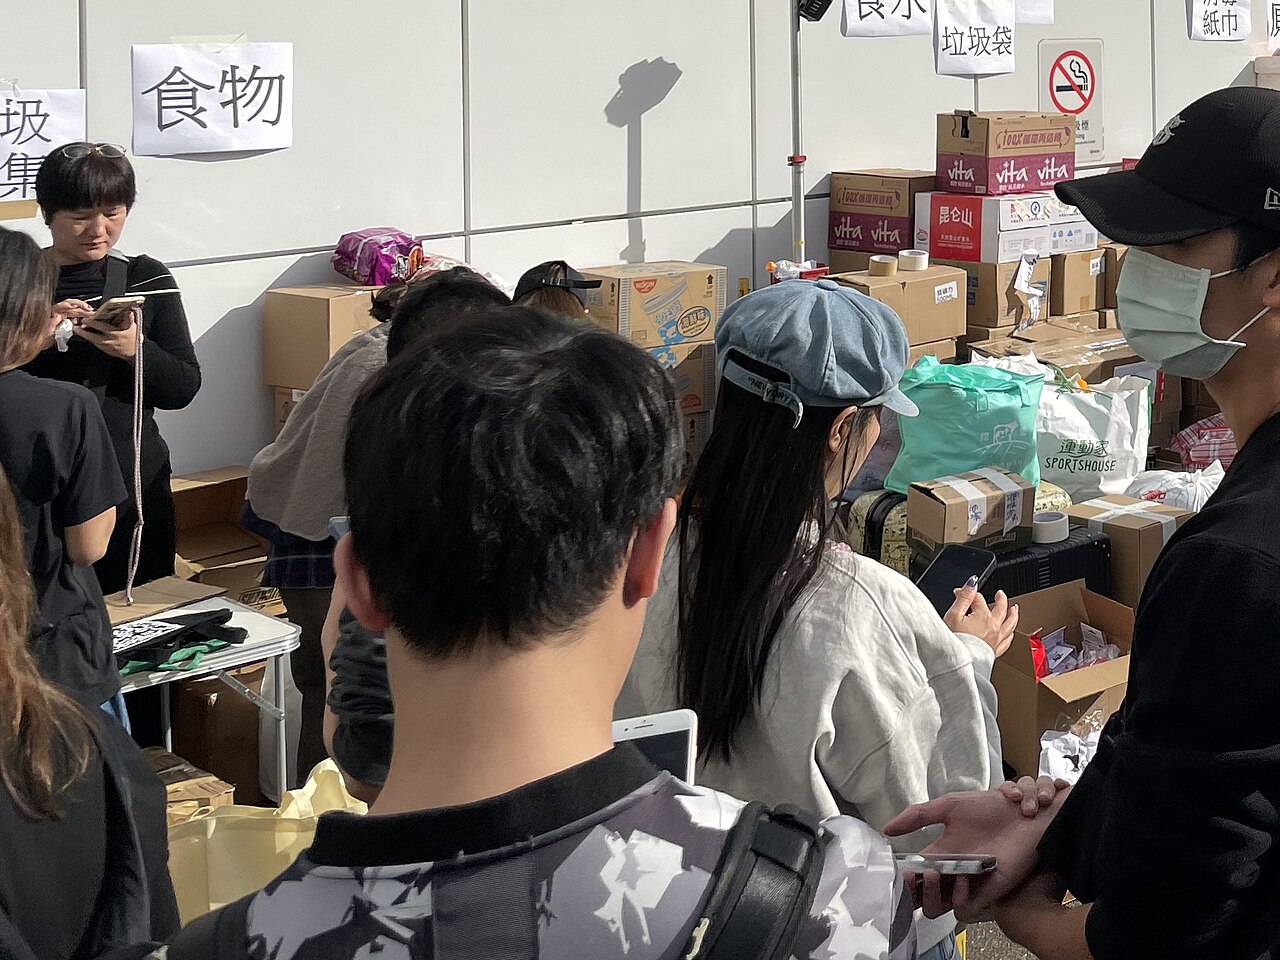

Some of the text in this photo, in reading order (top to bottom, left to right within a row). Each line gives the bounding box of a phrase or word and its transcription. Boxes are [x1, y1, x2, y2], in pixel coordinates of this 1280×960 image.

[1202, 10, 1239, 37] 紙巾
[941, 25, 1012, 57] 垃圾袋
[141, 65, 285, 132] 食物
[0, 98, 52, 146] 圾
[948, 159, 975, 182] vita
[996, 159, 1029, 184] vita
[1037, 156, 1069, 180] vita
[834, 216, 863, 240] vita
[939, 206, 974, 229] 昆仑山
[871, 219, 901, 244] vita
[1056, 439, 1110, 458] 運動家
[1045, 457, 1117, 473] SPORTSHOUSE
